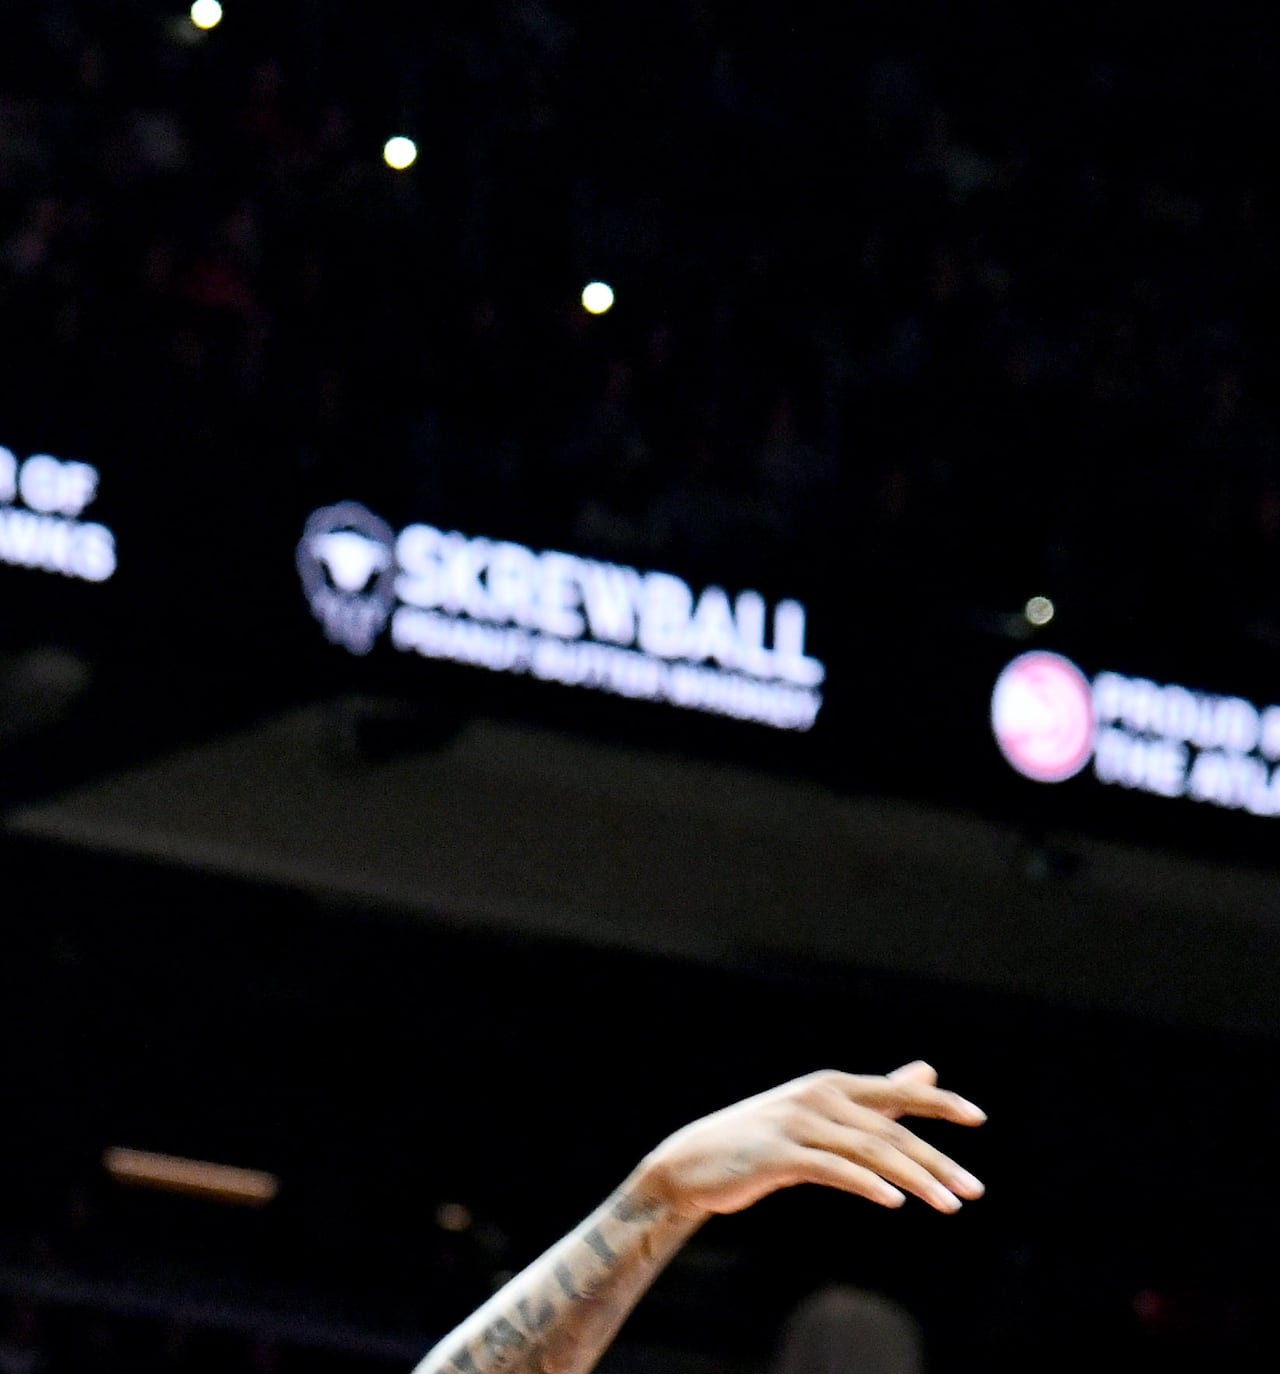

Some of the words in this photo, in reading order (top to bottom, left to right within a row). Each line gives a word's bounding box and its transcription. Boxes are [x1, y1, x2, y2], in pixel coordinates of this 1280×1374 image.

[19, 453, 100, 517] OF
[394, 523, 825, 687] SKREWBALL
[1091, 670, 1259, 752] PROUD
[1093, 728, 1187, 797] THE
